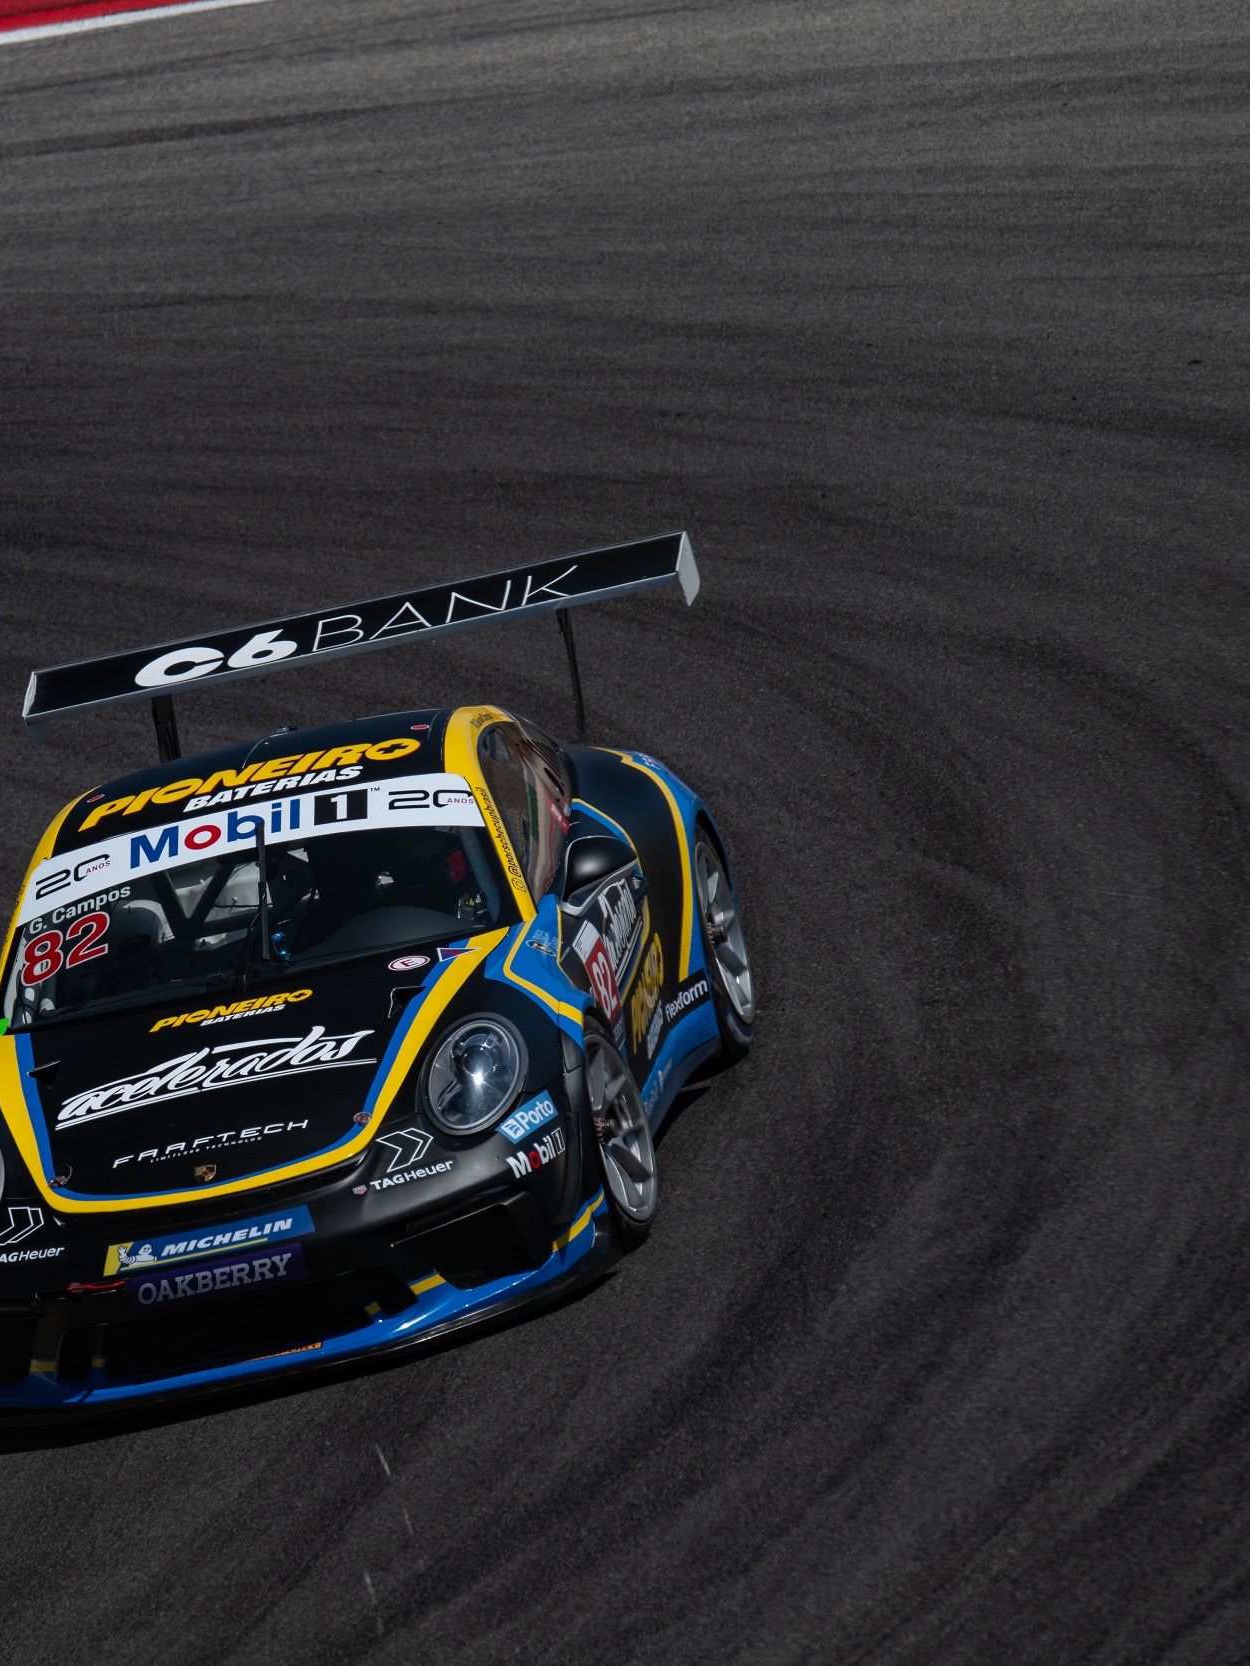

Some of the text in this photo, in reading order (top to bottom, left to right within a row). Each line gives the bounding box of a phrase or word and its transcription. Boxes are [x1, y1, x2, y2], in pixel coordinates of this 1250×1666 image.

[134, 564, 578, 688] C6 BANK
[77, 737, 422, 833] PIONEIRO
[183, 765, 364, 813] BATERIAS
[130, 798, 301, 870] Mobil
[85, 860, 111, 875] ANOS
[29, 886, 132, 935] G. Campos
[21, 911, 111, 987] 82
[592, 951, 618, 1021] 82
[148, 988, 313, 1034] PIONEIRO
[199, 1003, 287, 1027] BATERIAS
[514, 1099, 555, 1131] Porto
[506, 1134, 557, 1180] Mobil
[161, 1217, 294, 1258] MICHELIN
[137, 1252, 292, 1306] OAKBERRY
